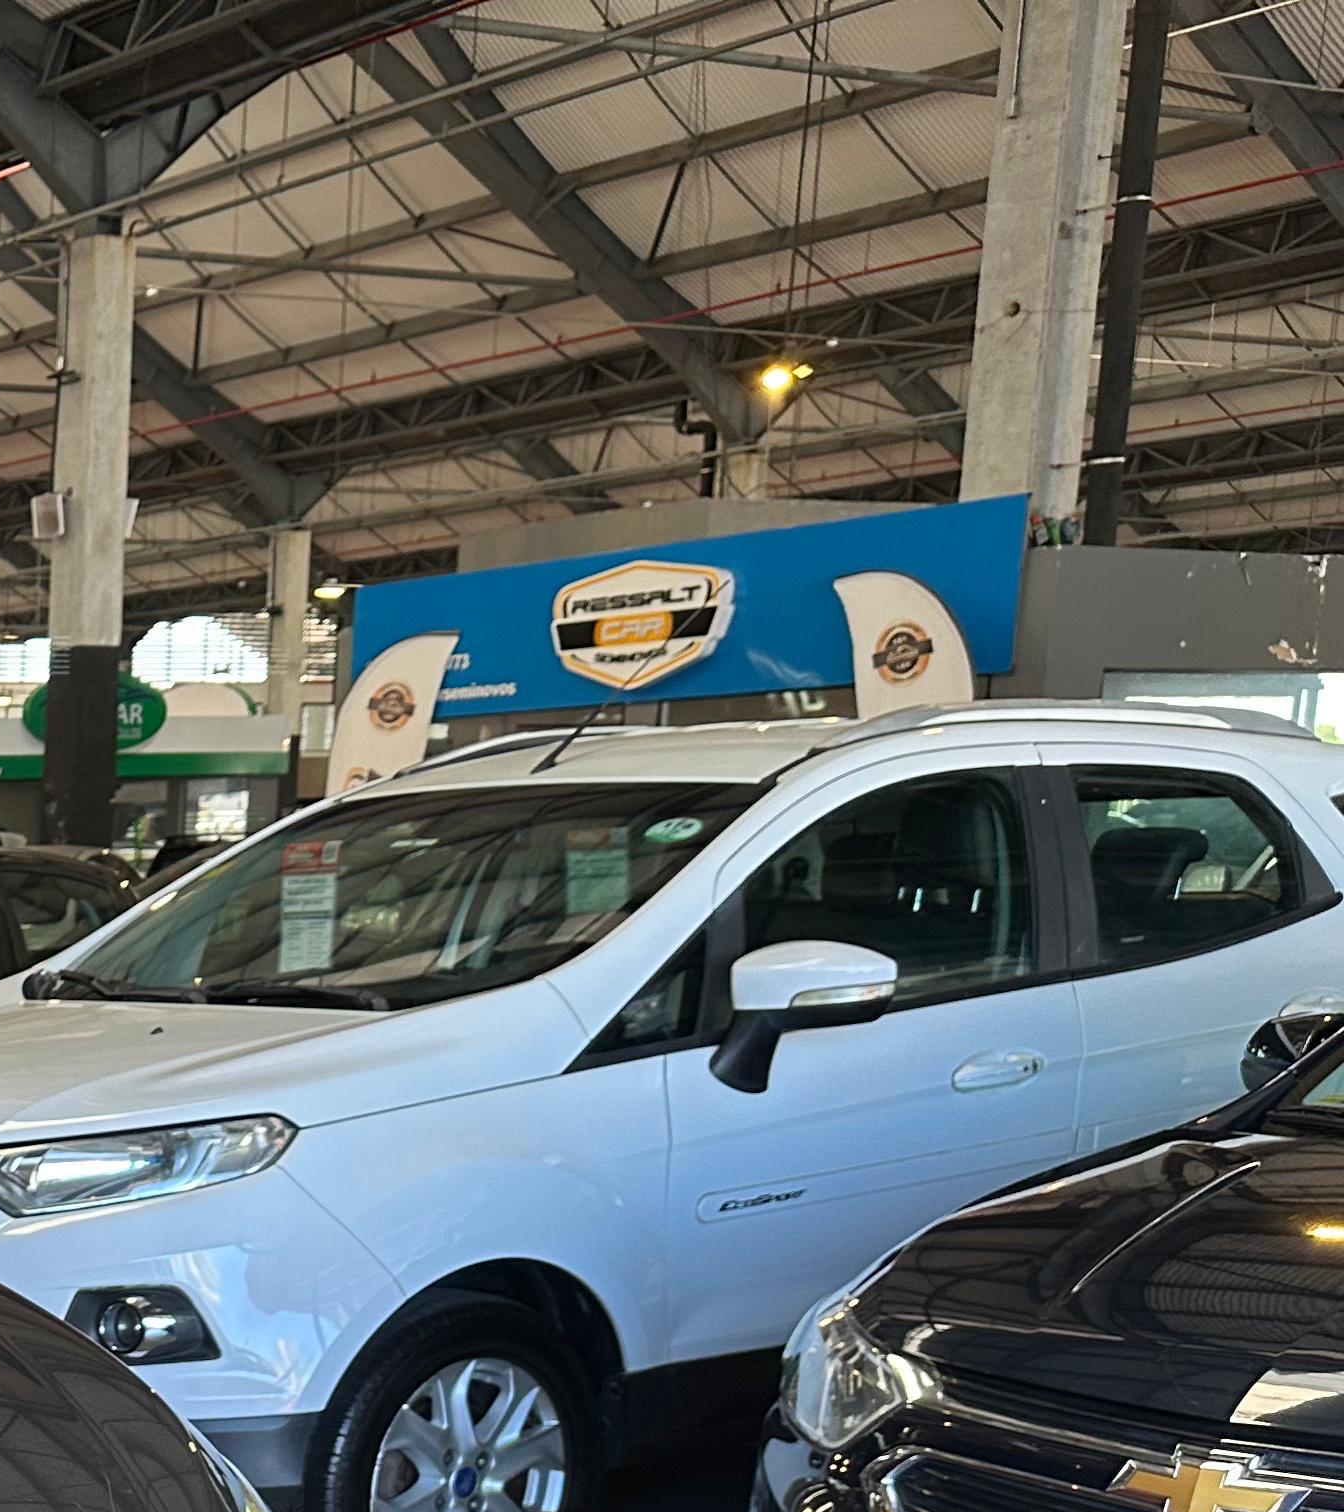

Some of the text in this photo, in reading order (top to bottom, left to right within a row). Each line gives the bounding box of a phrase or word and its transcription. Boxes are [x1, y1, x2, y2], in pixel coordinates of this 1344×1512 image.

[571, 585, 702, 614] RESSALT
[602, 615, 665, 642] CAR
[116, 702, 144, 725] AR
